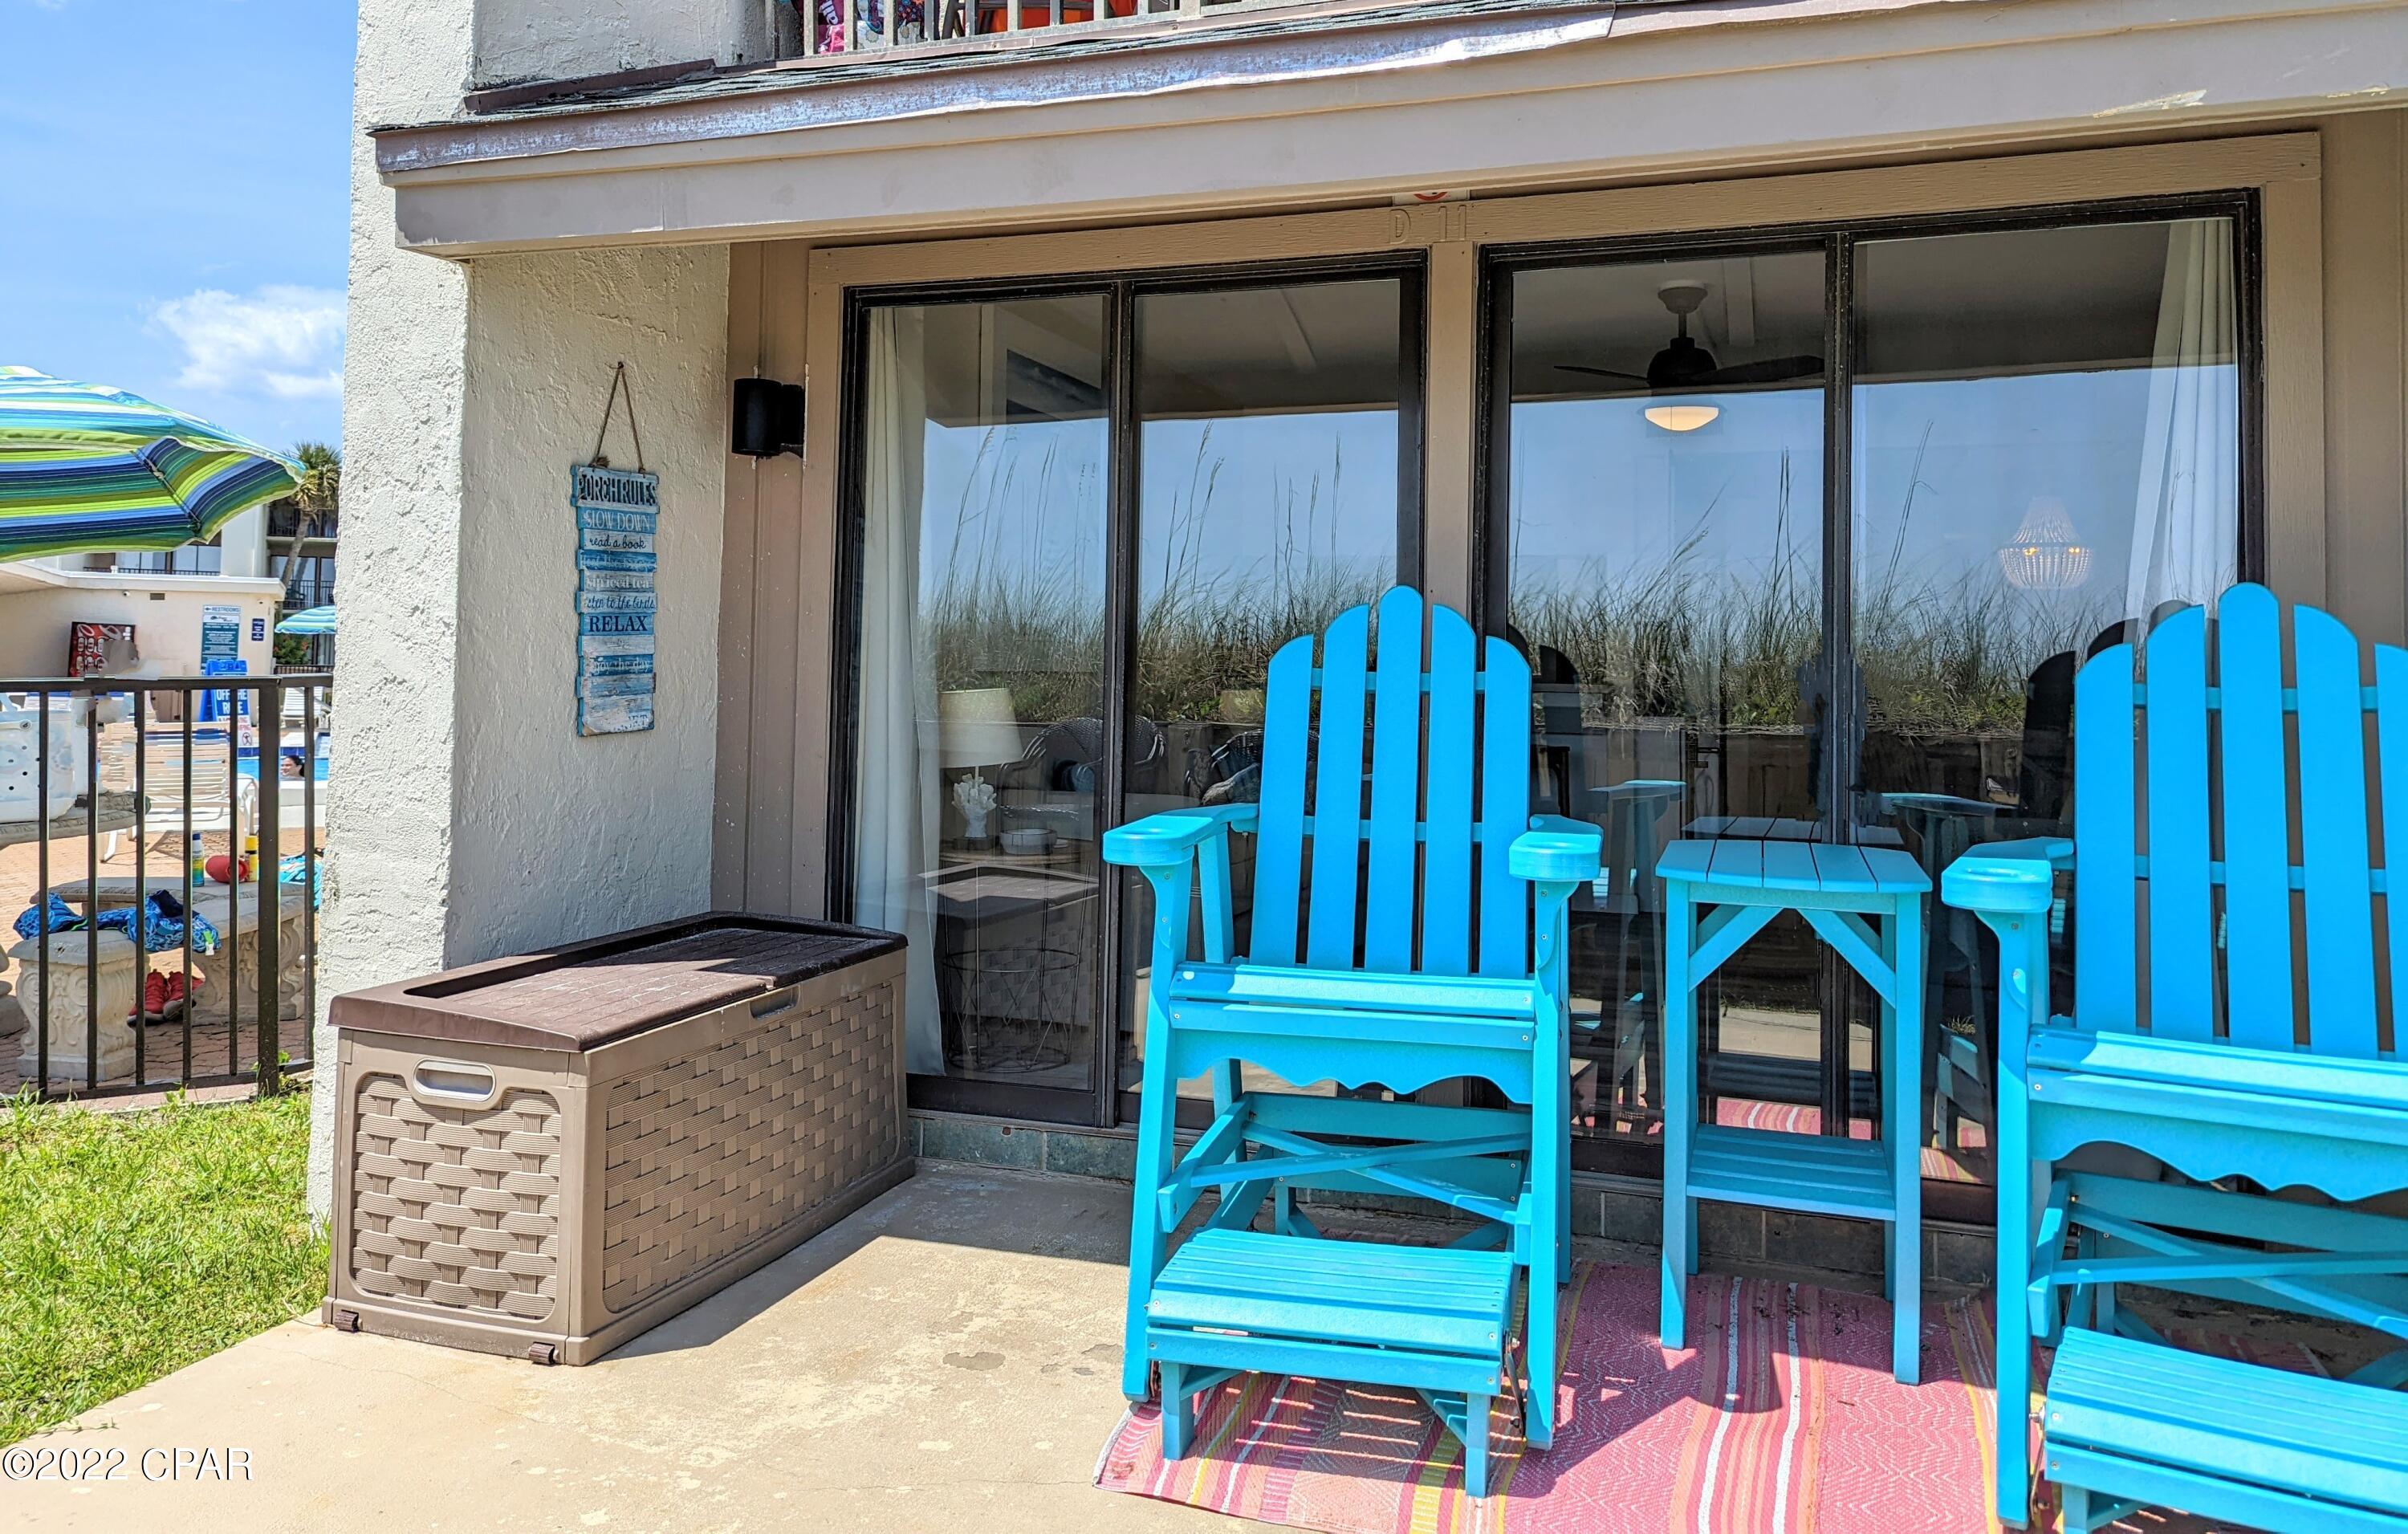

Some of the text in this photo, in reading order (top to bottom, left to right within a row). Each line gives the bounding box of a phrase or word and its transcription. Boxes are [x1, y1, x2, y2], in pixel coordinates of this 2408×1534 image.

[1389, 209, 1410, 244] D
[578, 474, 657, 506] PORCH RULES
[584, 510, 650, 531] SLOW DOWN
[589, 535, 647, 549] read a book
[606, 595, 616, 608] to
[588, 615, 649, 633] RELAX
